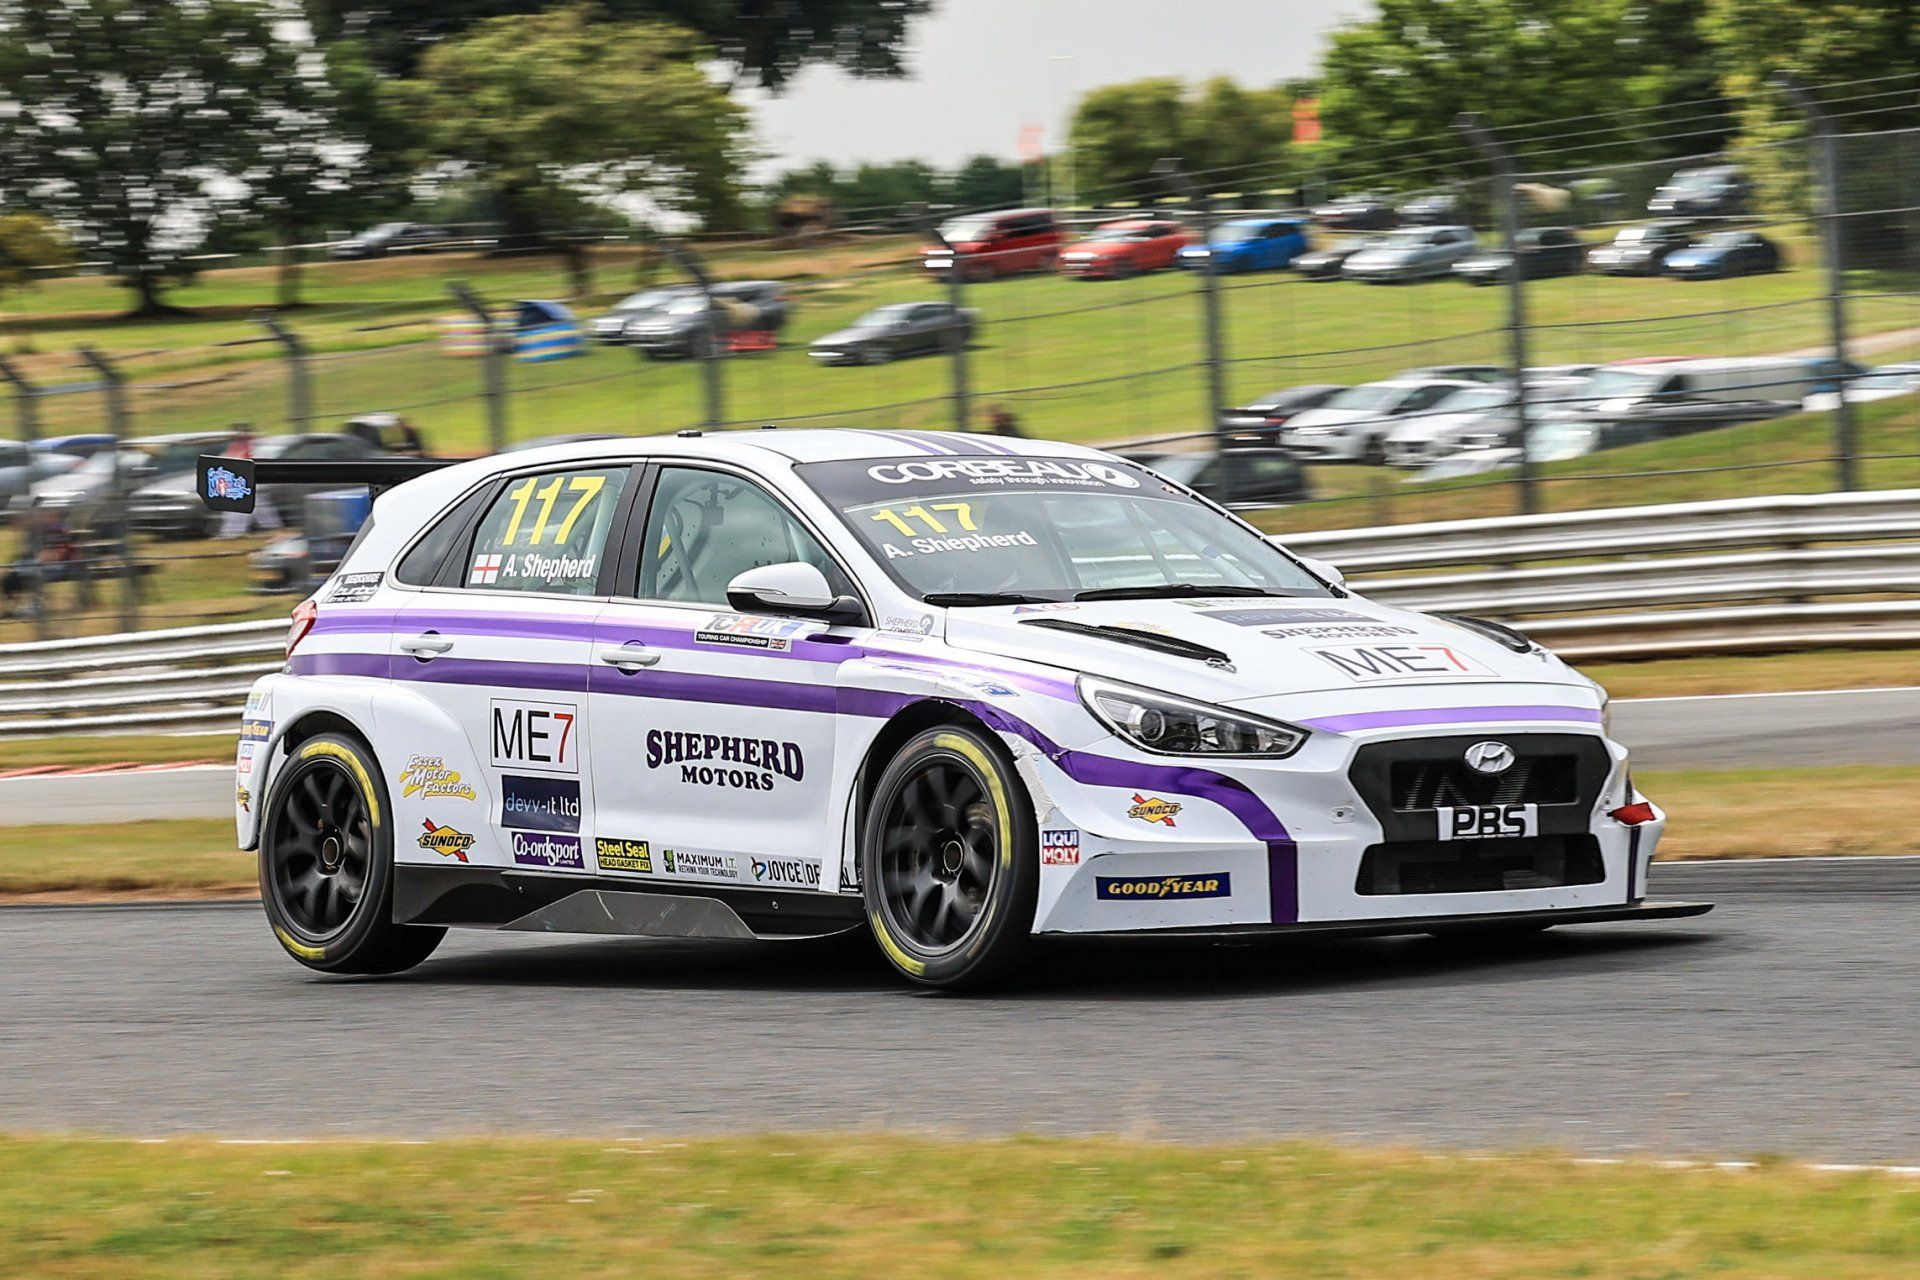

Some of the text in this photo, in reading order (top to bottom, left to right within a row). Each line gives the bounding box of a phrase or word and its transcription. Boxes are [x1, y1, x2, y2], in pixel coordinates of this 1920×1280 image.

[867, 459, 1092, 484] CORBEAU
[502, 476, 606, 546] 117
[870, 502, 979, 537] 117
[882, 530, 1038, 559] A. Shepherd
[502, 553, 597, 583] A. Shepherd
[885, 616, 920, 629] SHEPHERD
[698, 632, 768, 645] TOURING CAR CHAMPIONSHIP
[1261, 626, 1419, 640] SHEPHERD
[1316, 647, 1469, 676] ME7
[494, 707, 574, 764] ME7
[405, 753, 443, 773] Essex
[646, 729, 804, 782] SHEPHERD
[411, 768, 451, 787] Motor
[681, 765, 774, 791] MOTORS
[421, 781, 471, 801] Factors
[505, 792, 580, 817] devv-it ltd
[1132, 804, 1180, 817] SUNOCO
[1453, 804, 1526, 838] PBS
[422, 834, 471, 848] SUNOCO
[1043, 830, 1079, 847] LIQUI
[597, 839, 650, 859] Steel Seal
[1043, 848, 1079, 864] MOLY
[600, 857, 650, 870] HEAD GASKET FIX
[676, 852, 738, 870] MAXIMUM I.T.
[678, 864, 740, 879] RETHINK YOUR TECHNOLOGY
[767, 860, 803, 885] JOYCE
[1107, 878, 1220, 897] GOODYEAR
